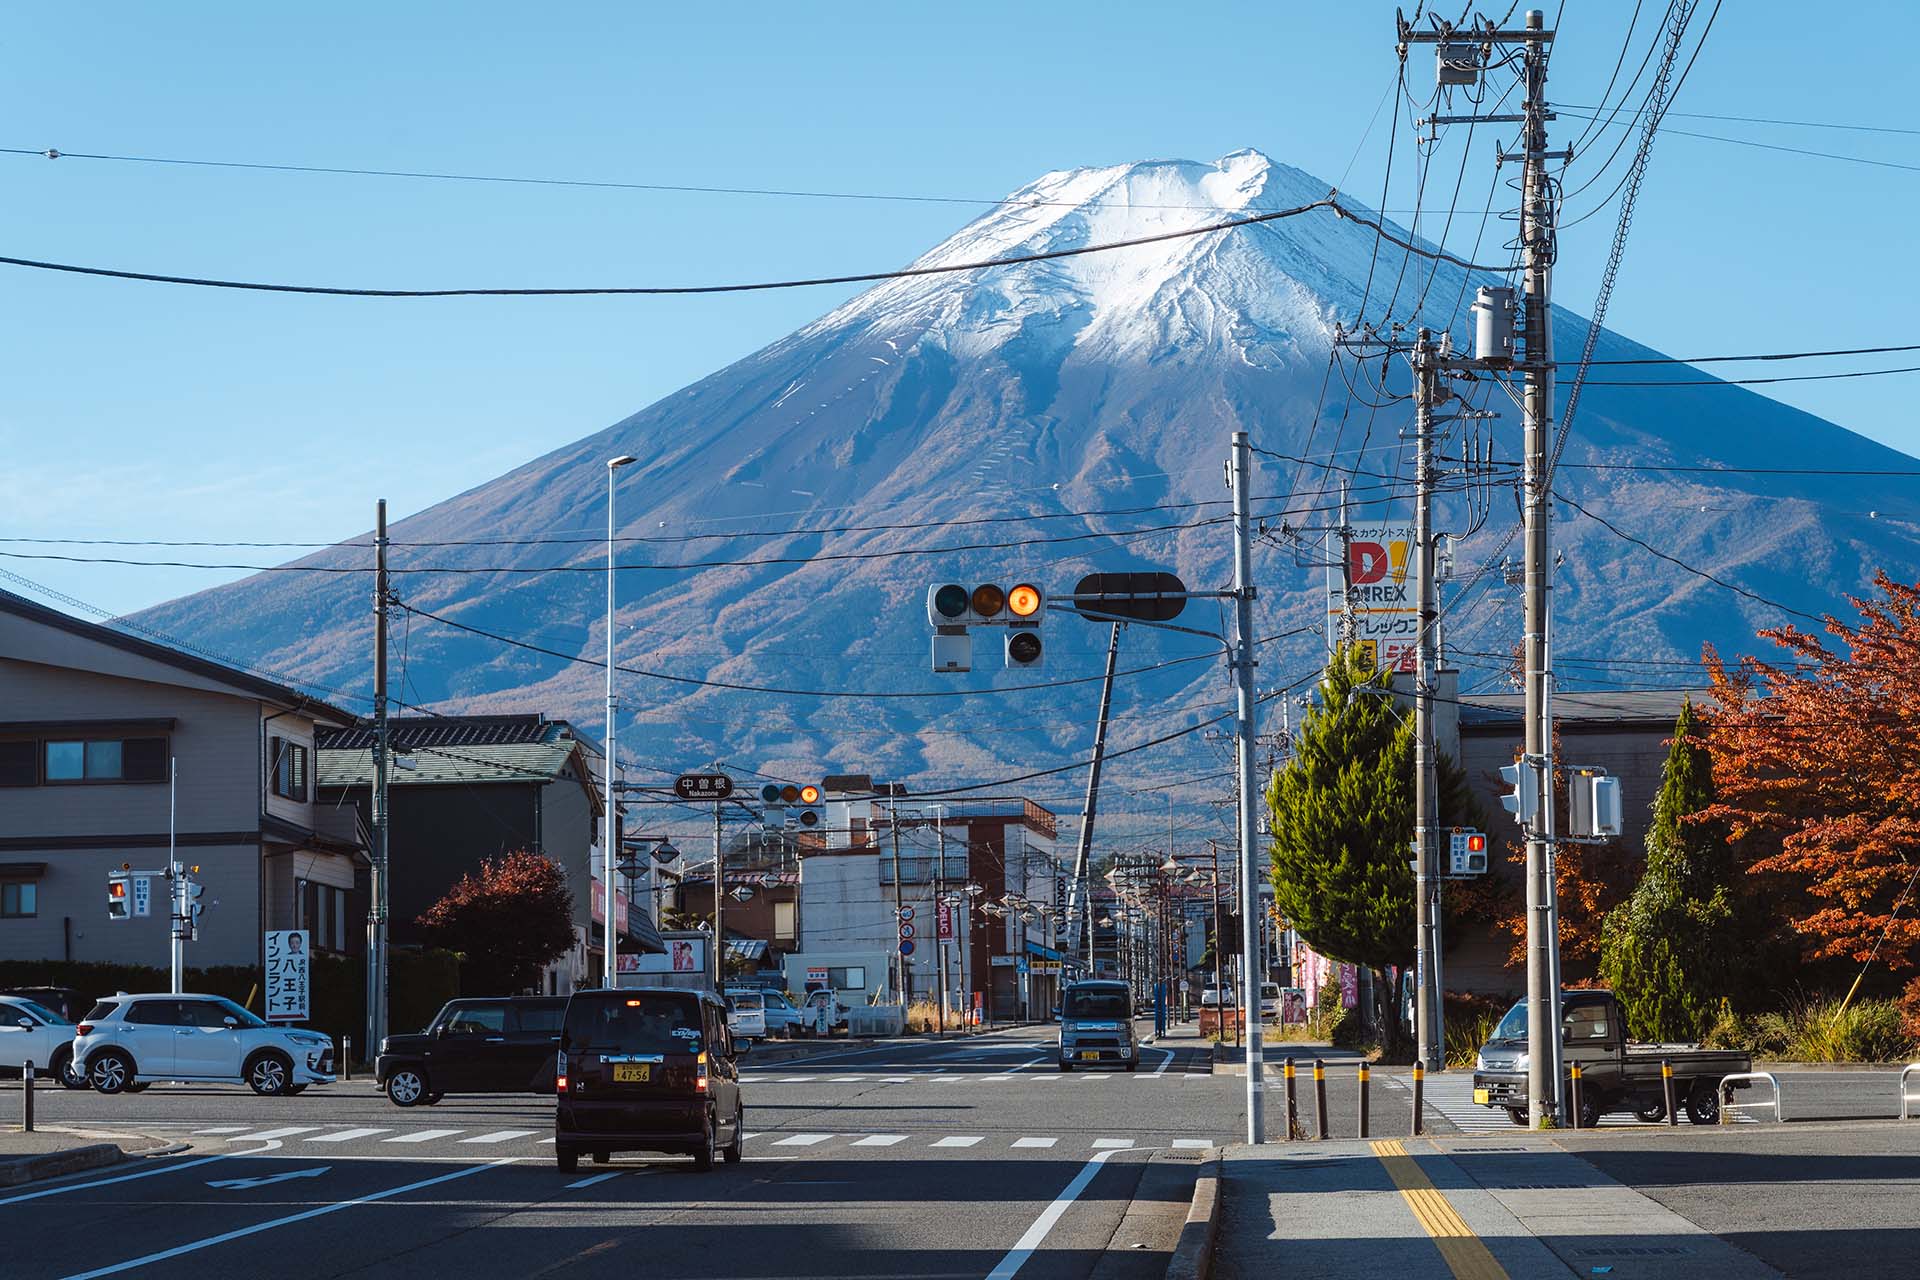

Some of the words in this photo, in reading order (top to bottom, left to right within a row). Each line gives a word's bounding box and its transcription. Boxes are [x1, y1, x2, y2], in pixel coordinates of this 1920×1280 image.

[682, 778, 726, 790] 中曽根
[268, 932, 281, 1012] インプラント
[283, 959, 297, 1011] 八王子
[621, 1070, 648, 1080] 47-56
